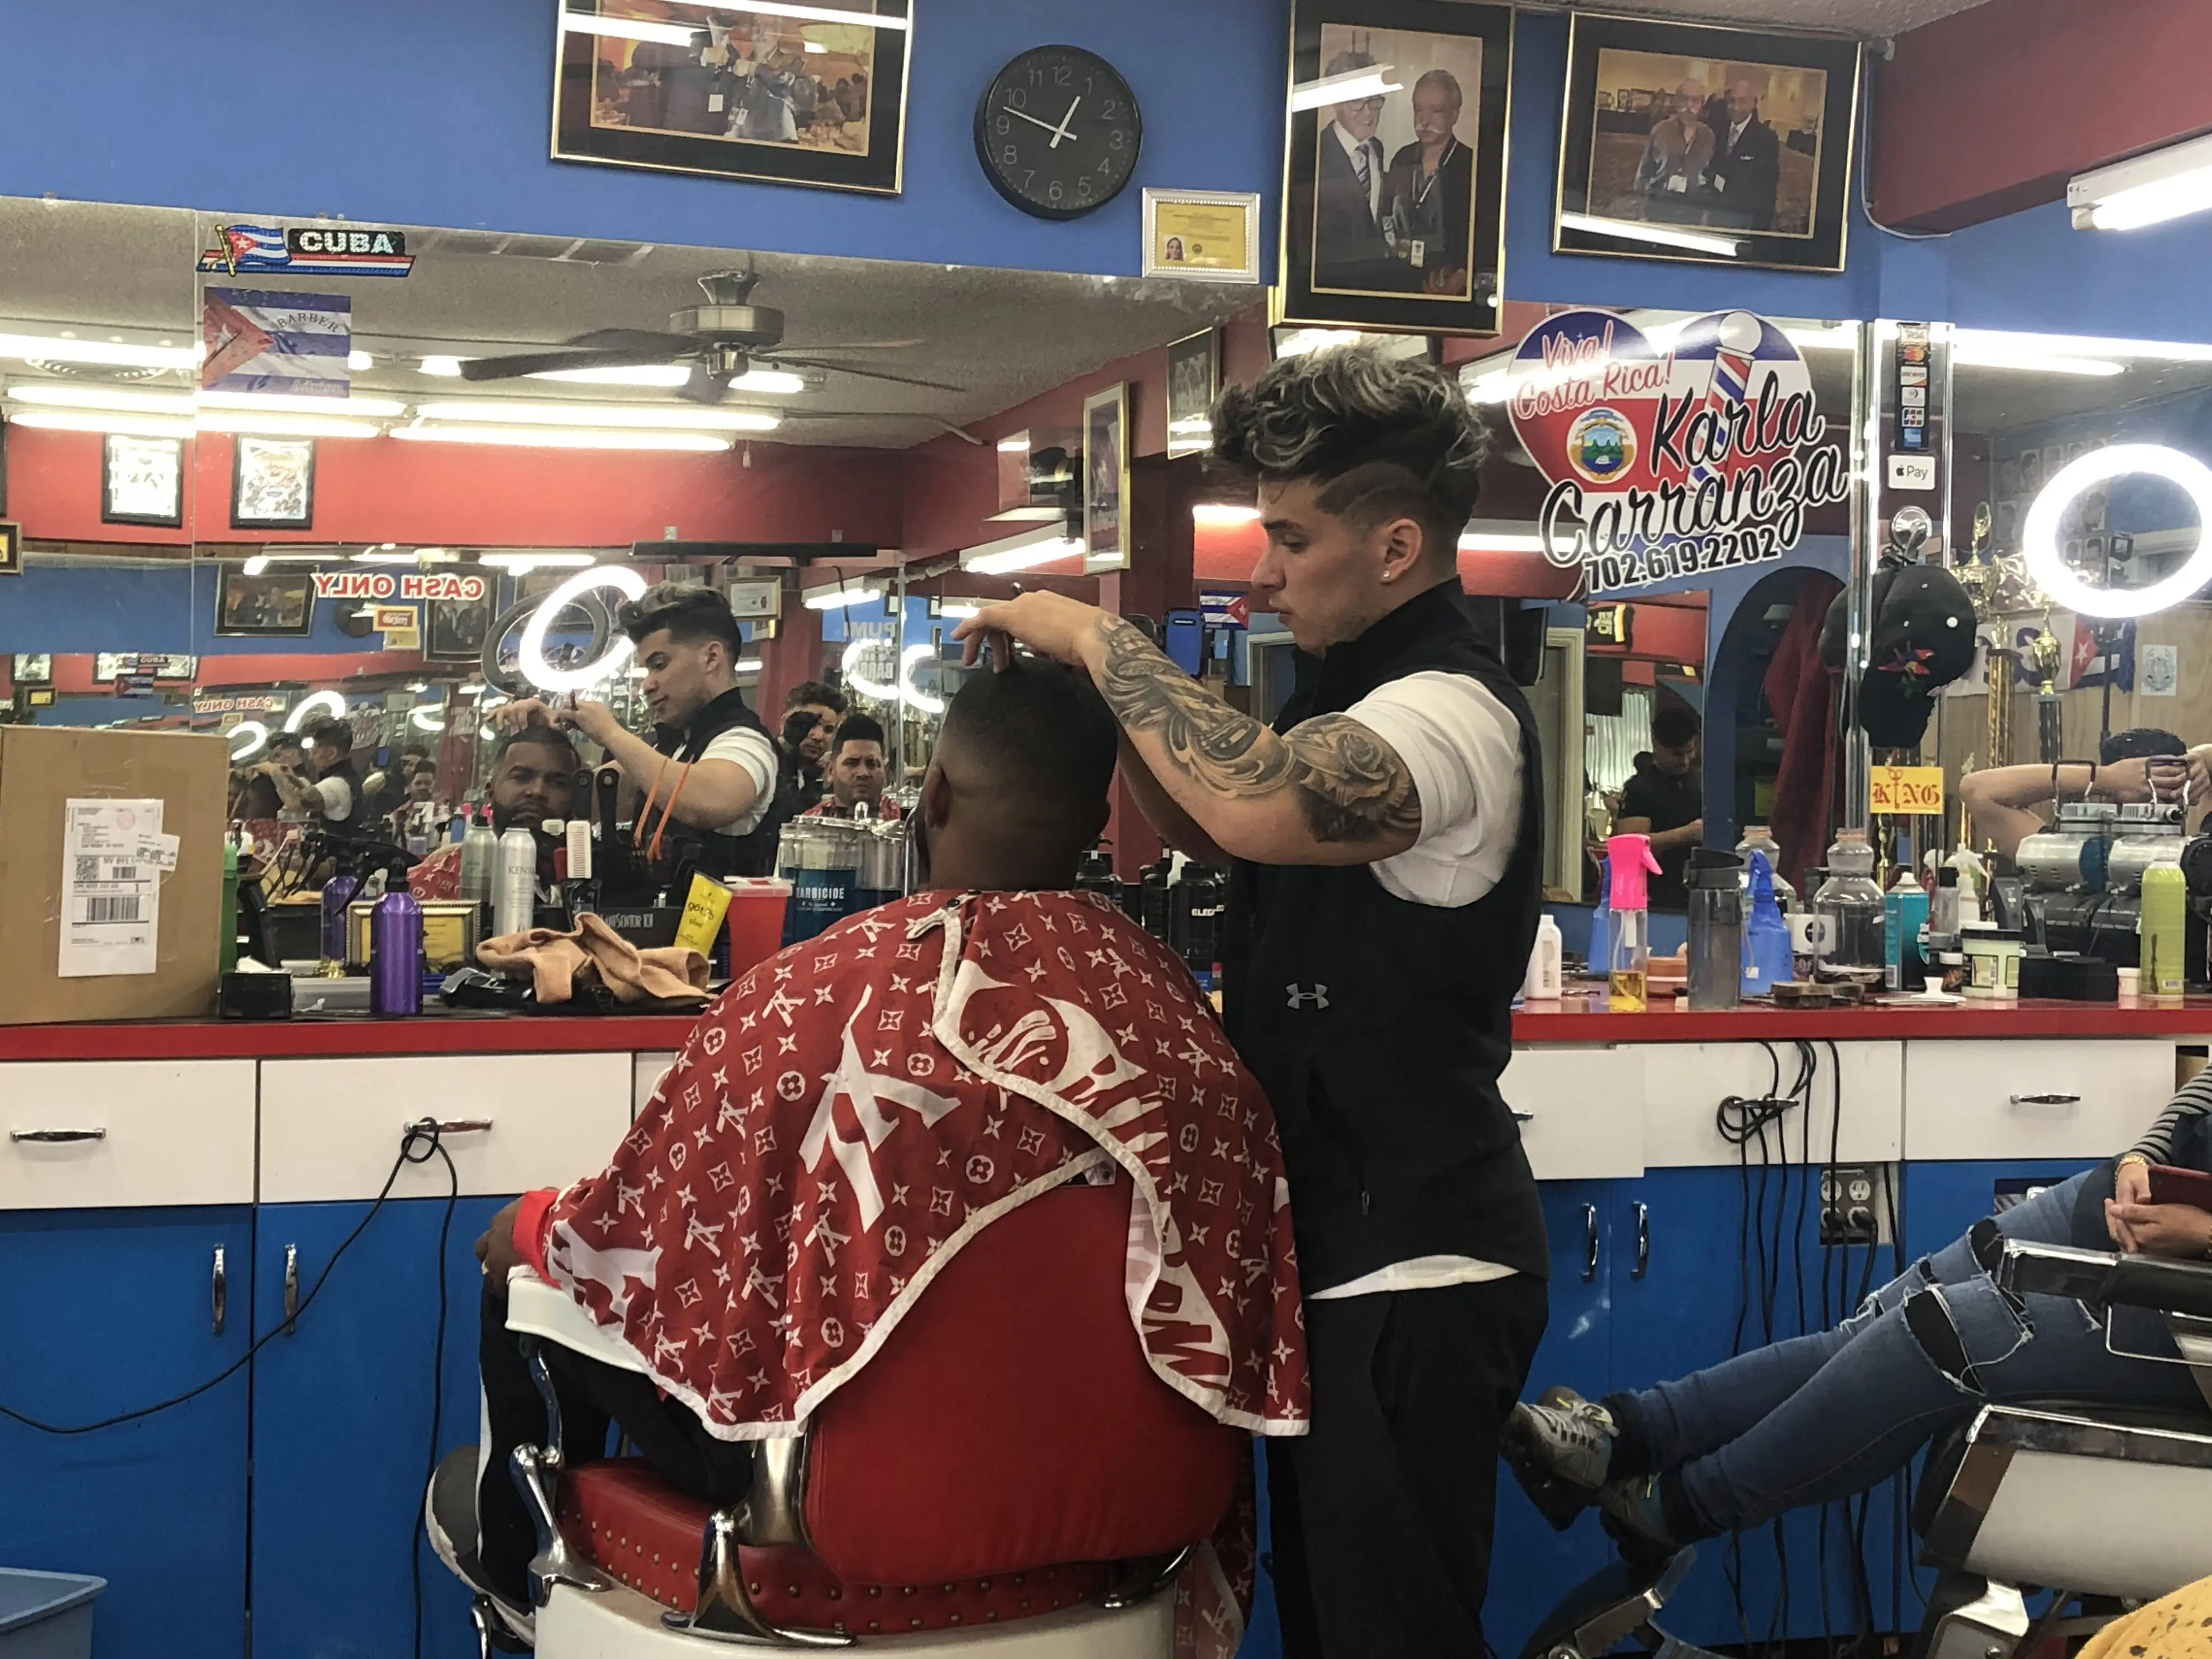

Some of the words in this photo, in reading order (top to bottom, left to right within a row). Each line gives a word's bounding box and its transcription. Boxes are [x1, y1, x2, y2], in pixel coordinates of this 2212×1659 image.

[1029, 68, 1042, 87] 11
[1052, 66, 1071, 86] 12
[1086, 77, 1092, 94] 1
[1006, 88, 1026, 109] 10
[1102, 100, 1115, 120] 2
[997, 115, 1009, 135] 9
[1109, 131, 1122, 150] 3
[1003, 145, 1017, 164] 8
[1097, 157, 1109, 176] 4
[1023, 170, 1035, 188] 7
[1078, 176, 1091, 196] 5
[1049, 180, 1063, 200] 6
[300, 231, 393, 254] CUBA
[278, 313, 338, 333] BARBER
[1543, 320, 1613, 370] Viva!
[1515, 377, 1595, 420] Costa
[1604, 349, 1675, 400] Rica!
[1652, 371, 1825, 475] Karla
[1906, 466, 1928, 480] Pay
[1542, 445, 1850, 567] Carranza
[1587, 528, 1779, 591] 702.619.2202
